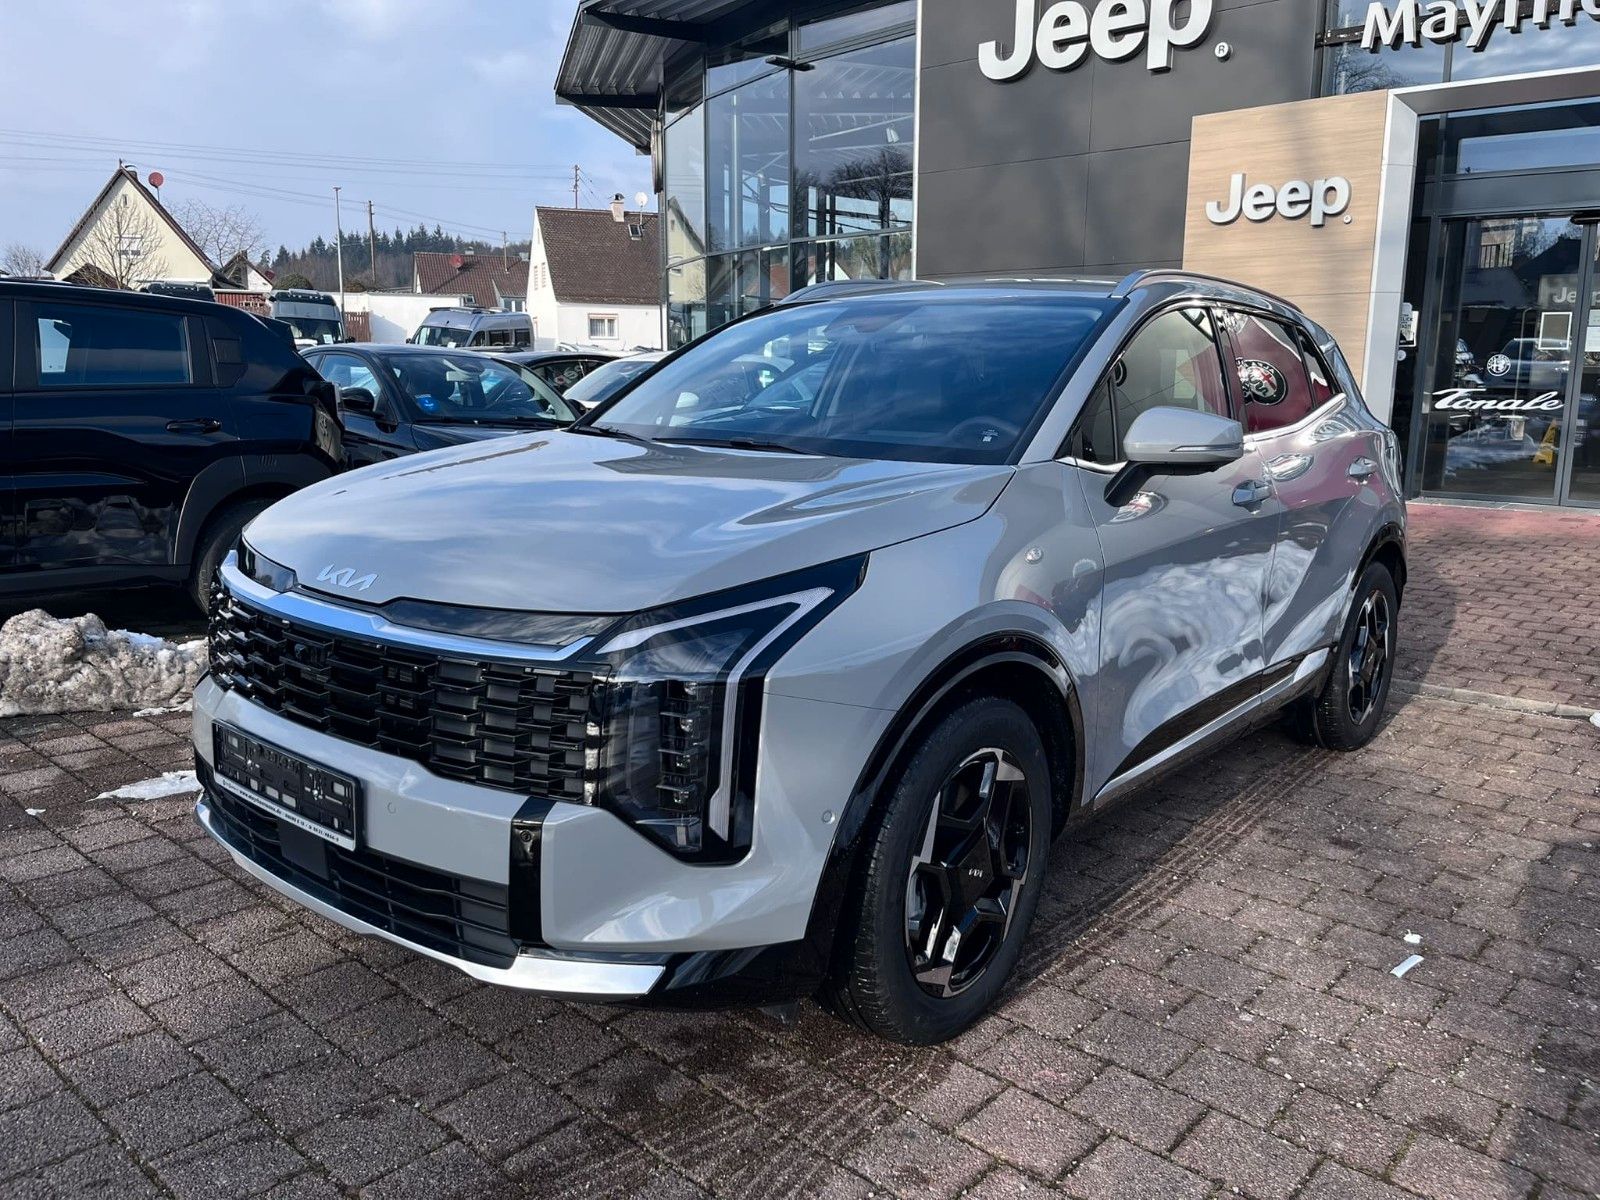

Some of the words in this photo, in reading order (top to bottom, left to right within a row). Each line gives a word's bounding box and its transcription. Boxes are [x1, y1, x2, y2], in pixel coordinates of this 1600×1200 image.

[978, 0, 1213, 80] Jeep
[1205, 172, 1351, 228] Jeep
[1432, 387, 1565, 411] Tonale
